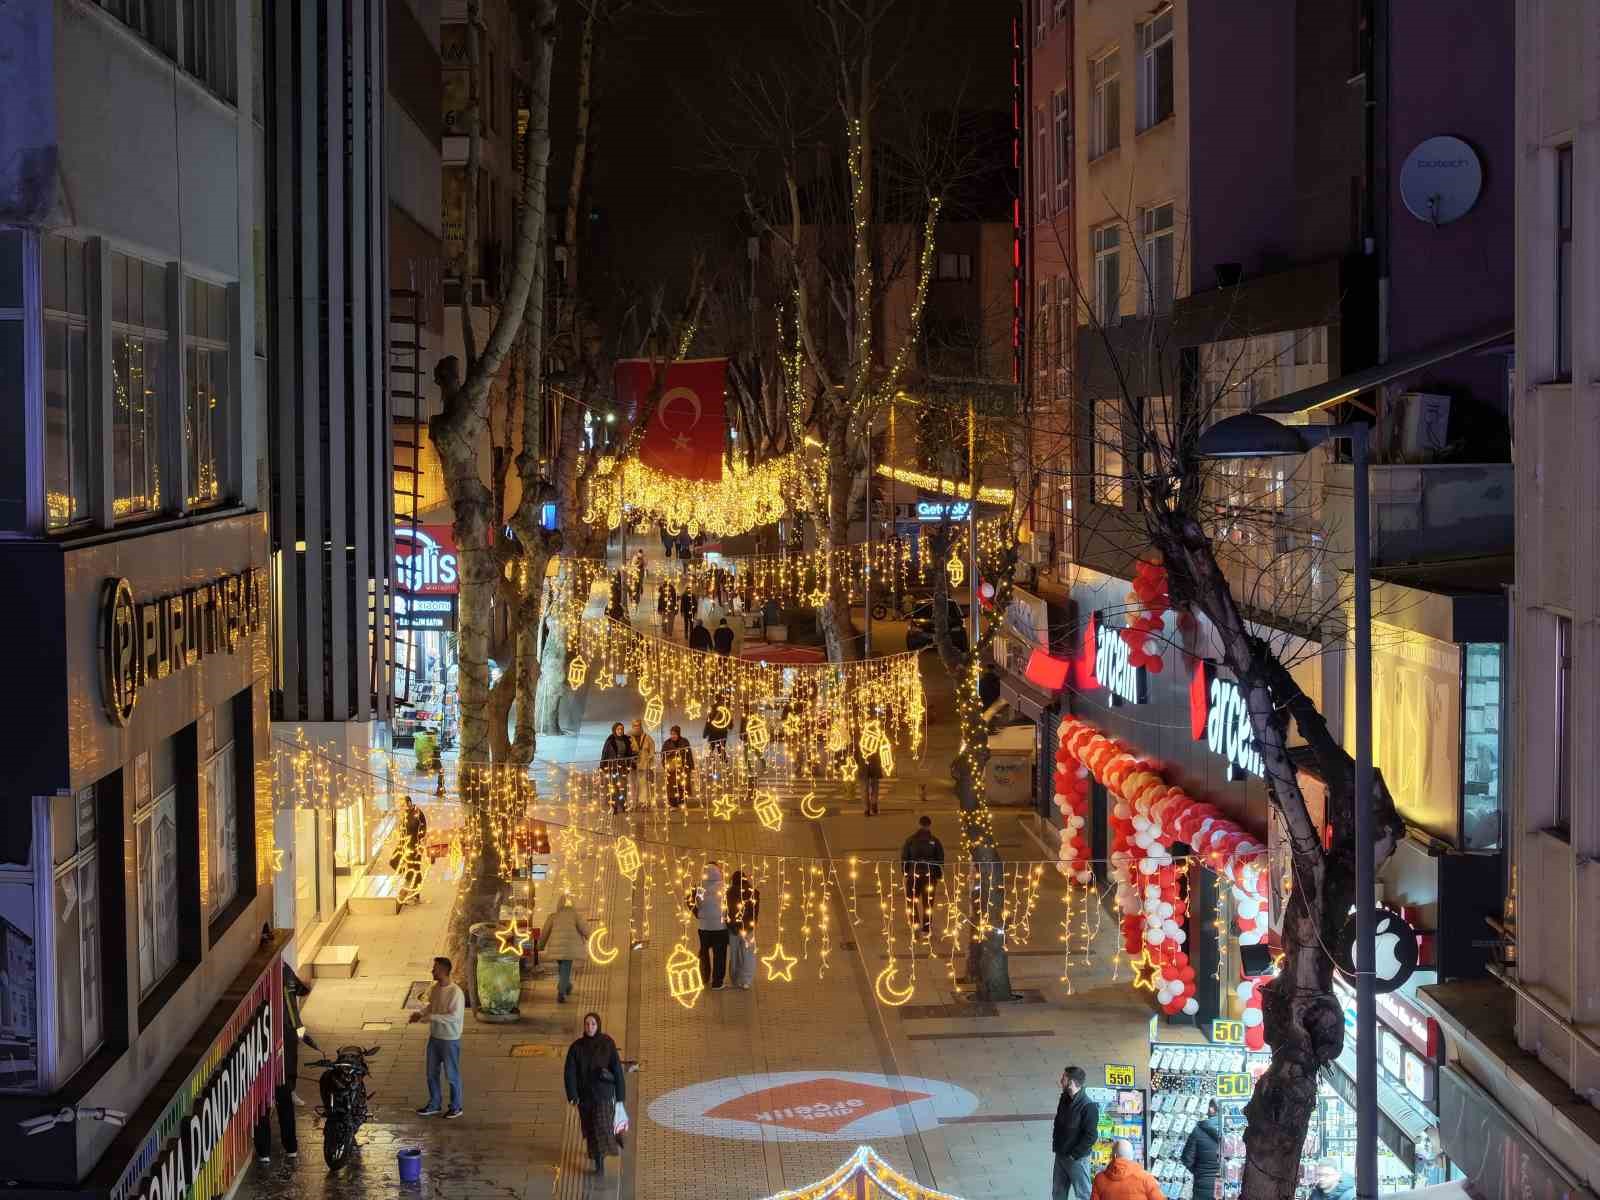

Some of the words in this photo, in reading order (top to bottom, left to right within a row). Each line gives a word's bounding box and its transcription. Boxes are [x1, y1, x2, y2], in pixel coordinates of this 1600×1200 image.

[1215, 1022, 1244, 1042] 50
[1109, 1073, 1132, 1085] 550
[1218, 1075, 1250, 1095] 50
[190, 1002, 273, 1183] DONDURMASI
